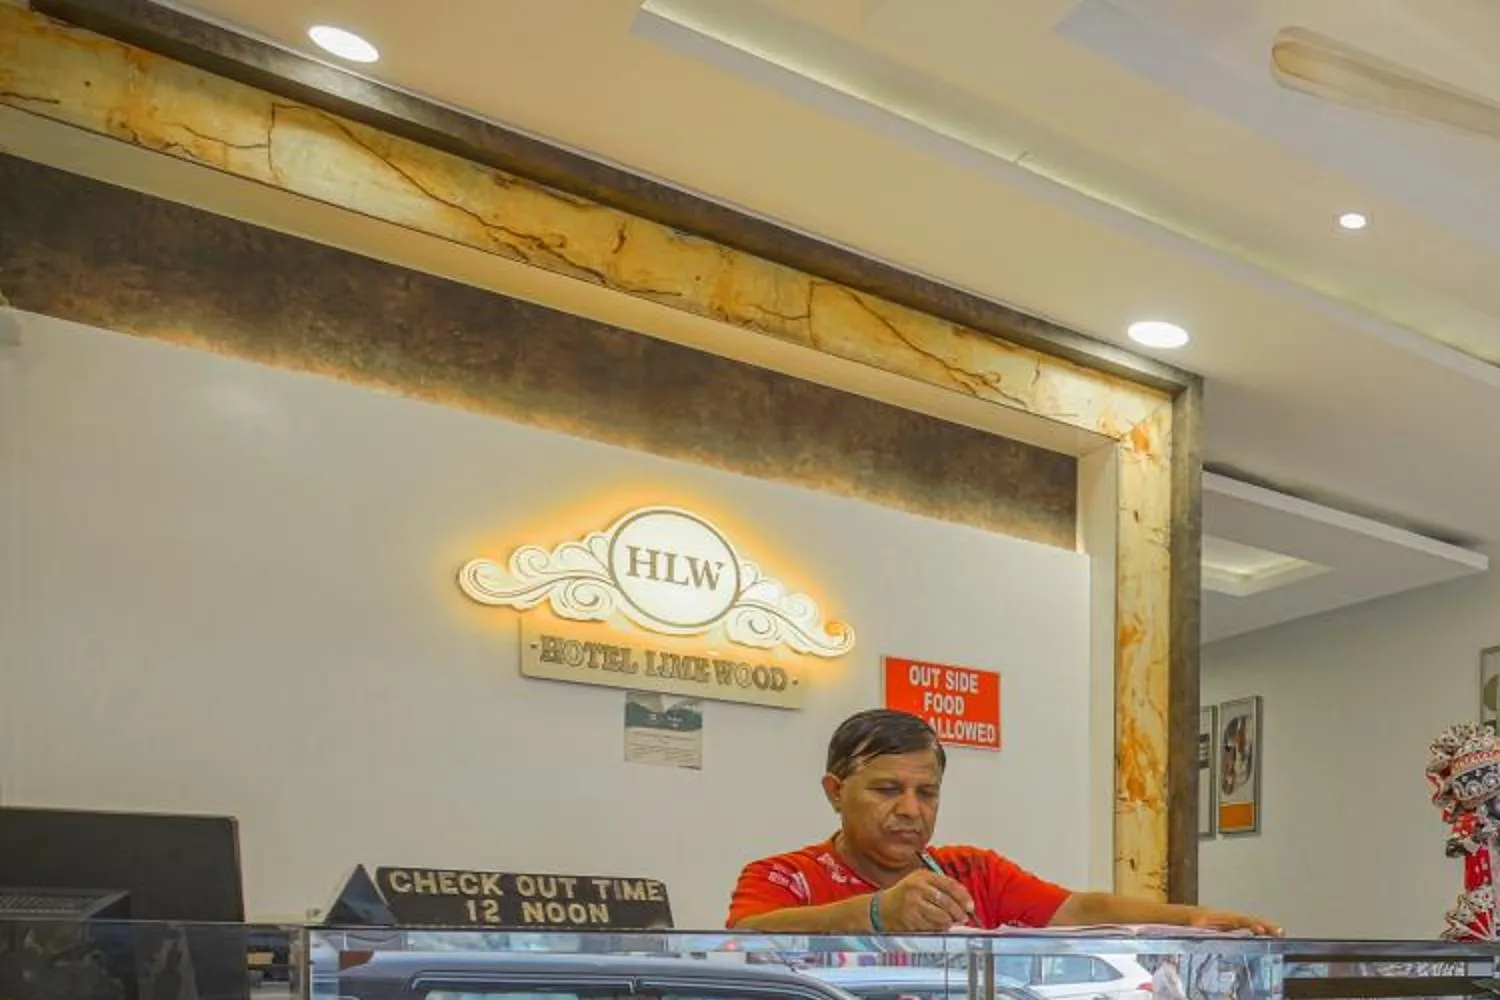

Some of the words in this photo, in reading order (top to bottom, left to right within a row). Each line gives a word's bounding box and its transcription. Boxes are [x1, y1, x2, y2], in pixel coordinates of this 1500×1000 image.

[625, 545, 724, 592] HLW
[539, 635, 638, 675] HOTEL
[645, 650, 711, 683] LIME
[713, 660, 787, 691] WOOD
[909, 665, 940, 688] OUT
[945, 670, 979, 694] SIDE
[924, 692, 965, 716] FOOD
[928, 717, 997, 743] ALLOWED
[389, 870, 504, 897] CHECK
[516, 875, 577, 899] OUT
[591, 877, 665, 902] TIME
[466, 899, 501, 922] 12
[522, 901, 610, 924] NOON
